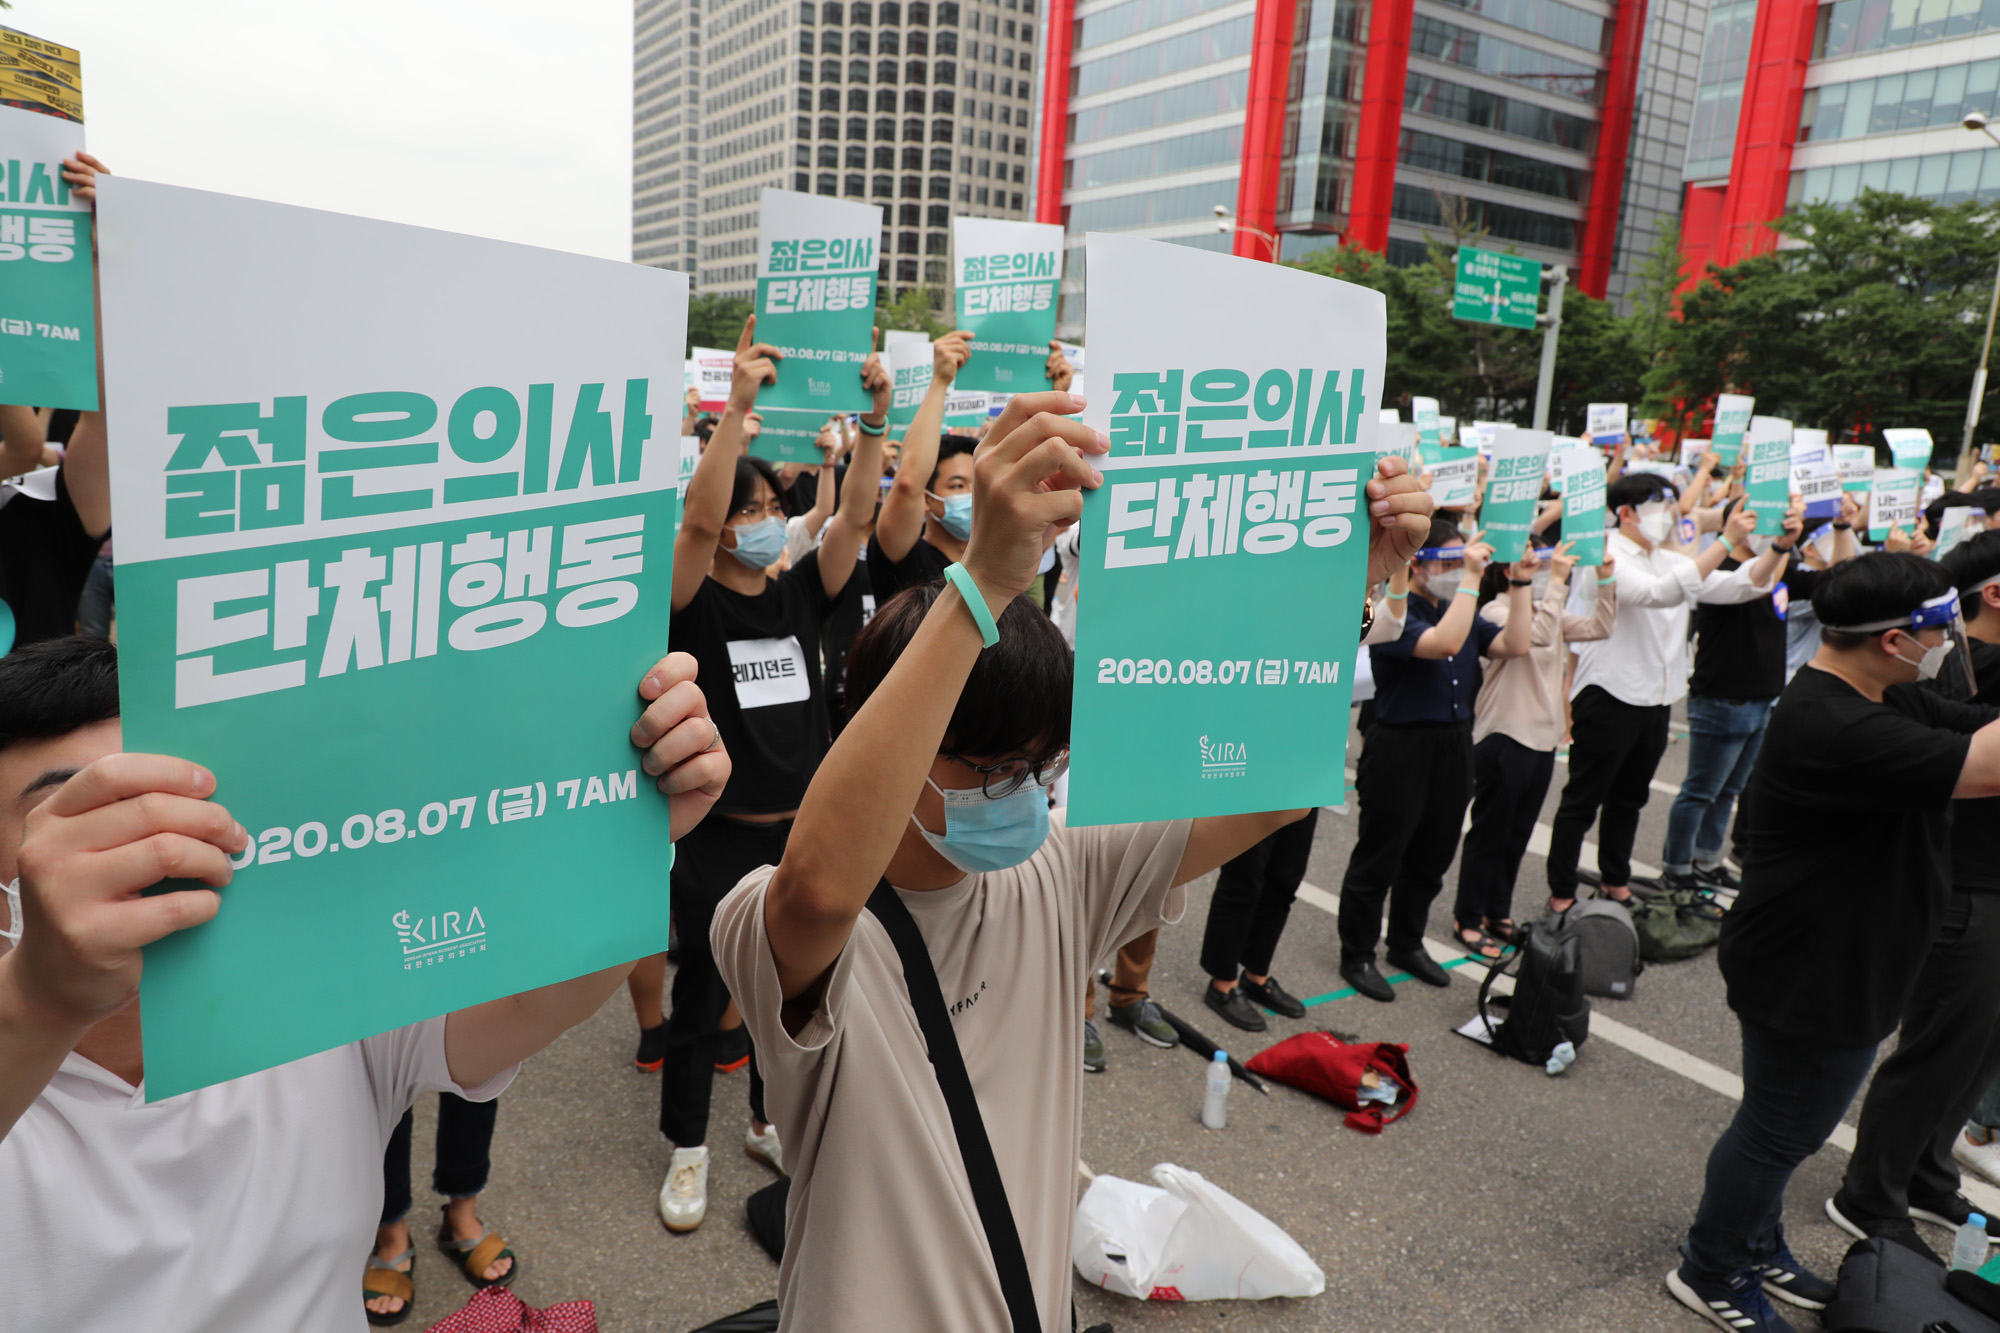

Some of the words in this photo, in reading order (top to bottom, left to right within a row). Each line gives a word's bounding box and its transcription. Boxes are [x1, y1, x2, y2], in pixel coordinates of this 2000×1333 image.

[768, 237, 873, 273] 젊은의사
[963, 251, 1055, 283] 젊은의사
[765, 276, 871, 314] 단체행동
[963, 283, 1053, 316] 단체행동
[36, 323, 80, 341] 7AM
[1109, 368, 1366, 458] 젊은의사
[164, 378, 653, 540] 젊은의사
[1104, 468, 1358, 569] 단체행동
[175, 514, 646, 710] 단체행동
[731, 657, 797, 683] 레지던트
[1097, 657, 1251, 685] 2020.08.07
[1255, 658, 1289, 685] (금)
[1294, 661, 1340, 684] 7AM
[226, 793, 478, 871] 020.08.07
[487, 781, 548, 826] (금)
[556, 769, 638, 811] 7AM
[411, 905, 486, 944] KIRA
